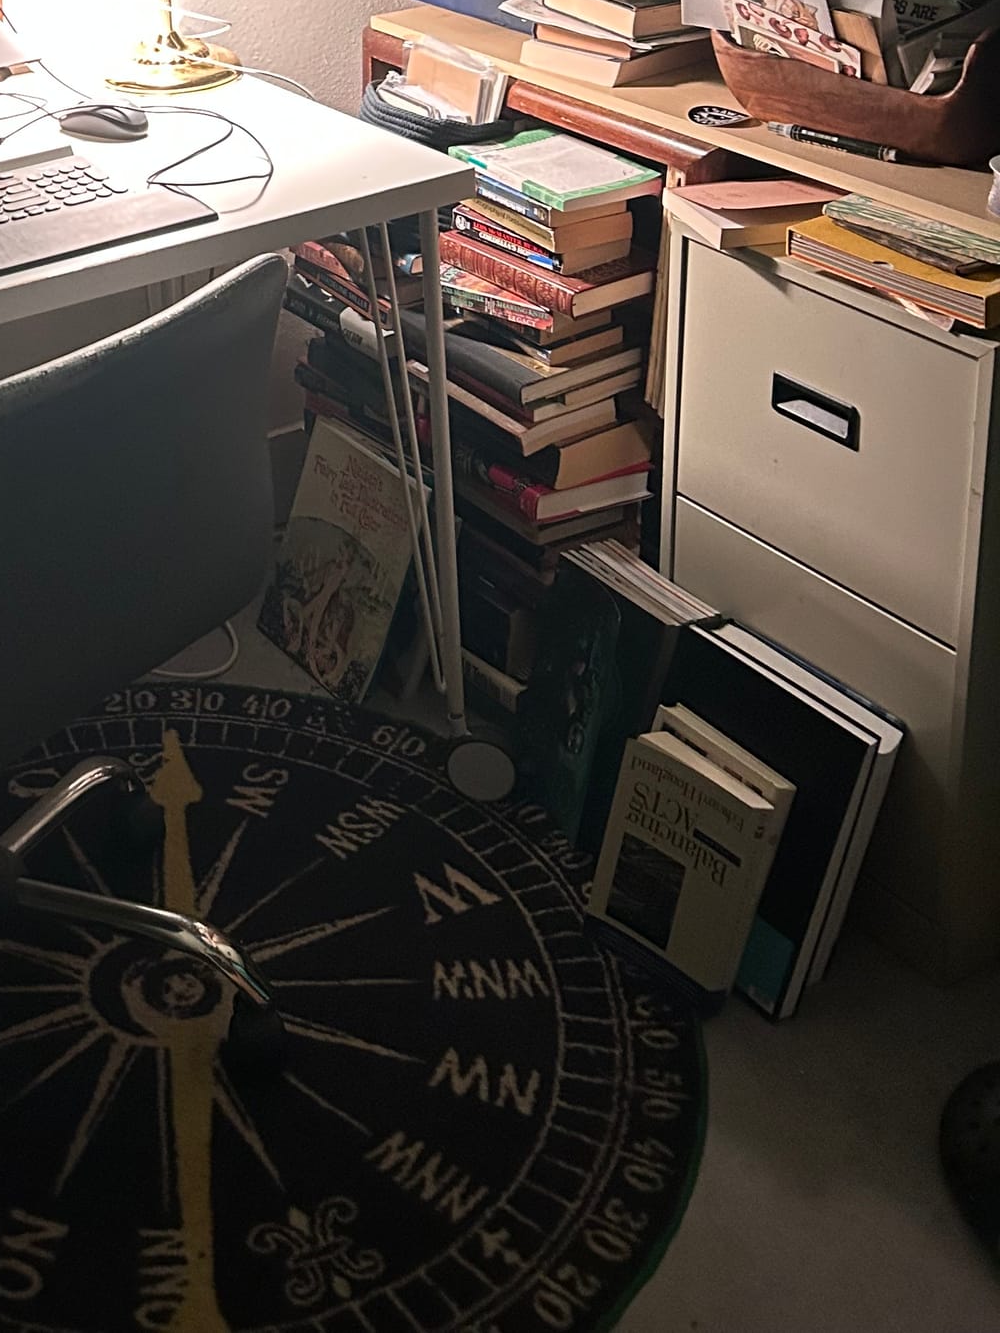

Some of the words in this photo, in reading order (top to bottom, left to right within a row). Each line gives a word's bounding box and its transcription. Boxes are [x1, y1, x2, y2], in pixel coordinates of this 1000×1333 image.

[910, 3, 939, 21] ARE
[633, 780, 696, 834] ACTS
[625, 797, 728, 887] Balancing
